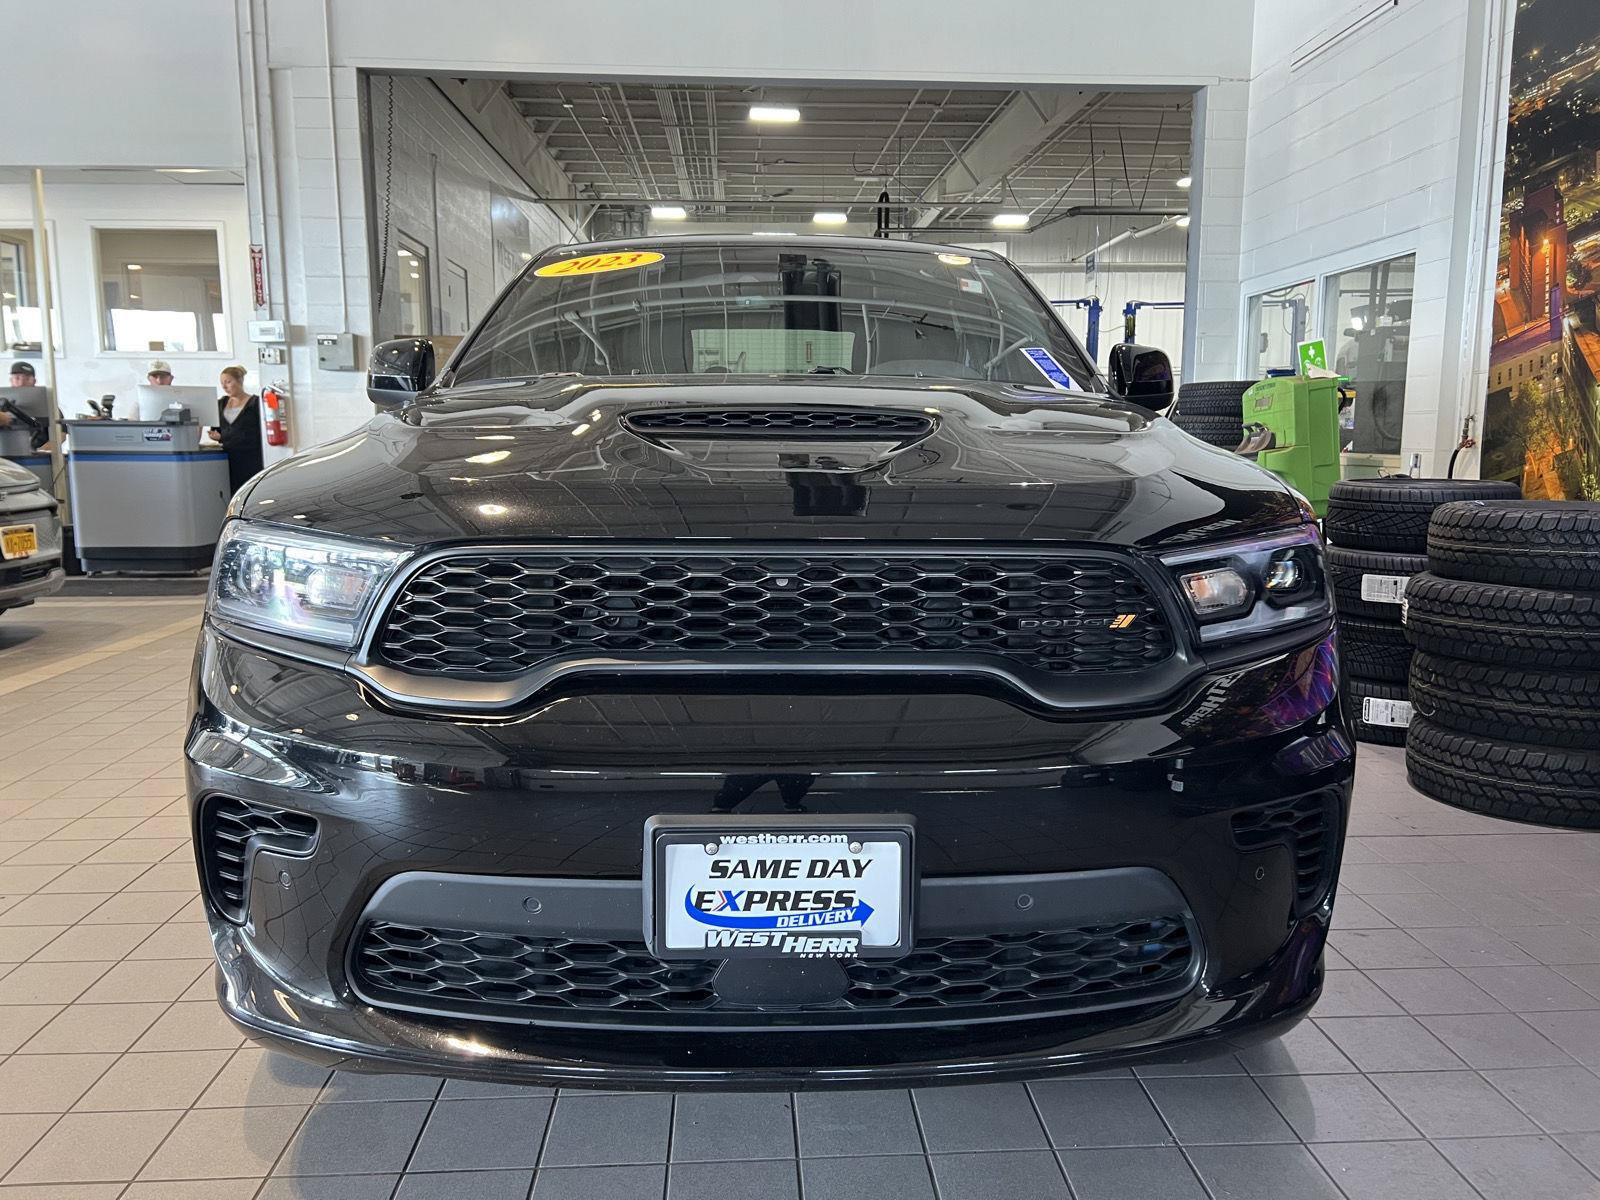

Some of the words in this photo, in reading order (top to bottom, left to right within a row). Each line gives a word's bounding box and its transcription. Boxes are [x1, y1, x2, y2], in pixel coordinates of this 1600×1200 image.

[554, 253, 643, 274] 2023
[719, 833, 848, 845] westherr.com
[708, 859, 802, 879] SAME
[806, 859, 874, 879] DAY
[694, 890, 857, 912] EXPRESS
[776, 907, 857, 928] DELIVERY
[705, 929, 788, 949] WEST
[781, 936, 859, 953] HERR
